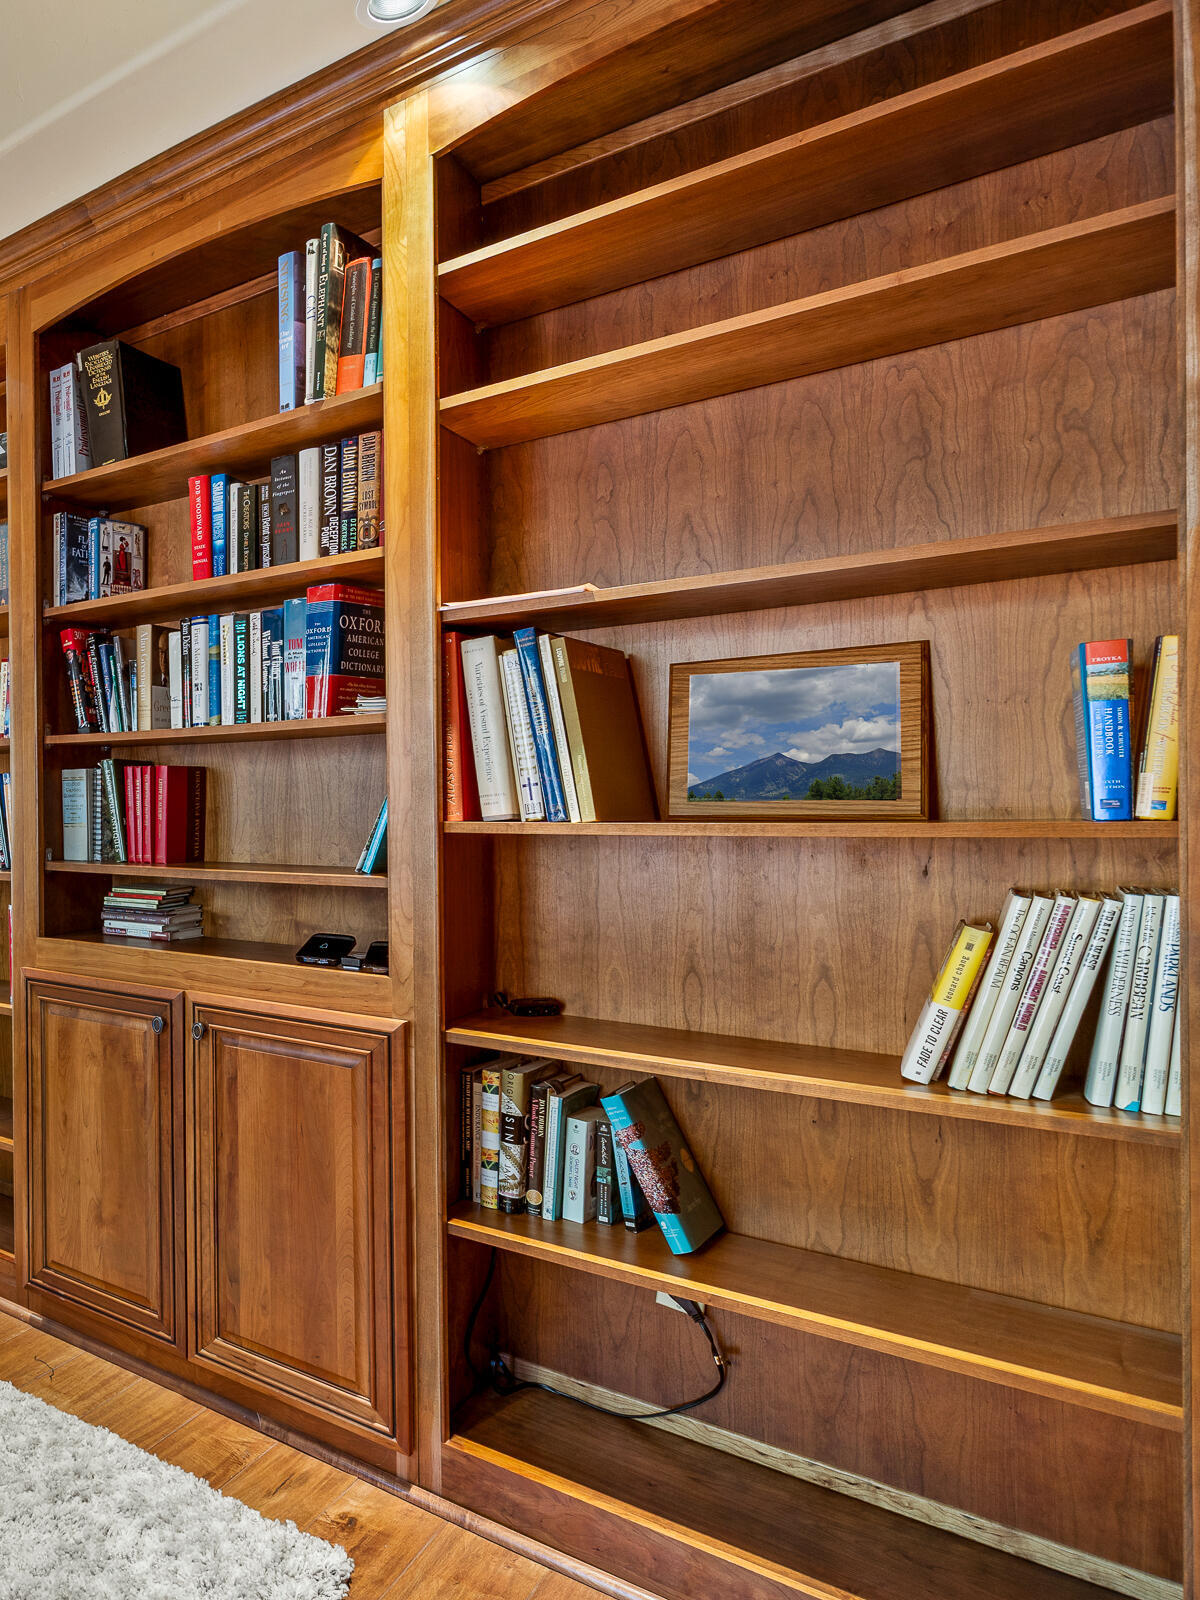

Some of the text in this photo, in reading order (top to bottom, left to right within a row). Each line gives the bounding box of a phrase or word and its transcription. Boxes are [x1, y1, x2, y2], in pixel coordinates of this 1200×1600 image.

[280, 260, 290, 324] NURSING
[306, 295, 316, 322] CAT
[316, 273, 329, 328] ELEPHANT
[361, 435, 376, 453] DAN
[324, 446, 338, 516] DAN BROWN
[342, 446, 357, 513] DAN BROWN
[361, 453, 377, 482] BROWN
[212, 480, 224, 512] SHADOW
[195, 496, 203, 541] WOODWARD
[349, 518, 357, 550] DIGITAL
[321, 526, 329, 548] POINT
[329, 516, 339, 556] DECEPTION
[141, 630, 149, 650] Alan
[305, 626, 332, 635] OXFORD
[339, 615, 385, 635] OXFOR
[346, 634, 385, 647] AMERICAN
[288, 638, 303, 650] TOM
[348, 648, 380, 660] COLLEGE
[237, 634, 245, 710] LIONS AT NIGHT
[340, 661, 385, 674] DICTIONARY
[474, 661, 494, 783] Varieties of Visual Experience
[1104, 707, 1114, 755] HANDBOOK
[1116, 706, 1124, 723] SIMON
[1095, 722, 1104, 759] WRITERS
[1117, 731, 1125, 758] SCHUSTER
[104, 769, 121, 853] KNOW YOUR ANTIQUES
[1010, 950, 1033, 992] Canyons
[1051, 933, 1083, 995] Sunset Coast
[1082, 943, 1104, 971] WEST
[1107, 903, 1137, 1017] INTO THE WILDERNESS
[943, 954, 971, 1003] leonard chang
[1129, 945, 1153, 1021] CARIBBEAN
[1158, 942, 1180, 1013] PARKLANDS
[916, 1008, 949, 1069] FADE TO CLEAR
[505, 1073, 515, 1142] ORIGINAL SIN
[530, 1120, 538, 1128] of
[531, 1103, 539, 1120] Book
[537, 1098, 546, 1138] JOAN DIDION
[529, 1128, 538, 1157] Common
[527, 1157, 536, 1179] Prayer
